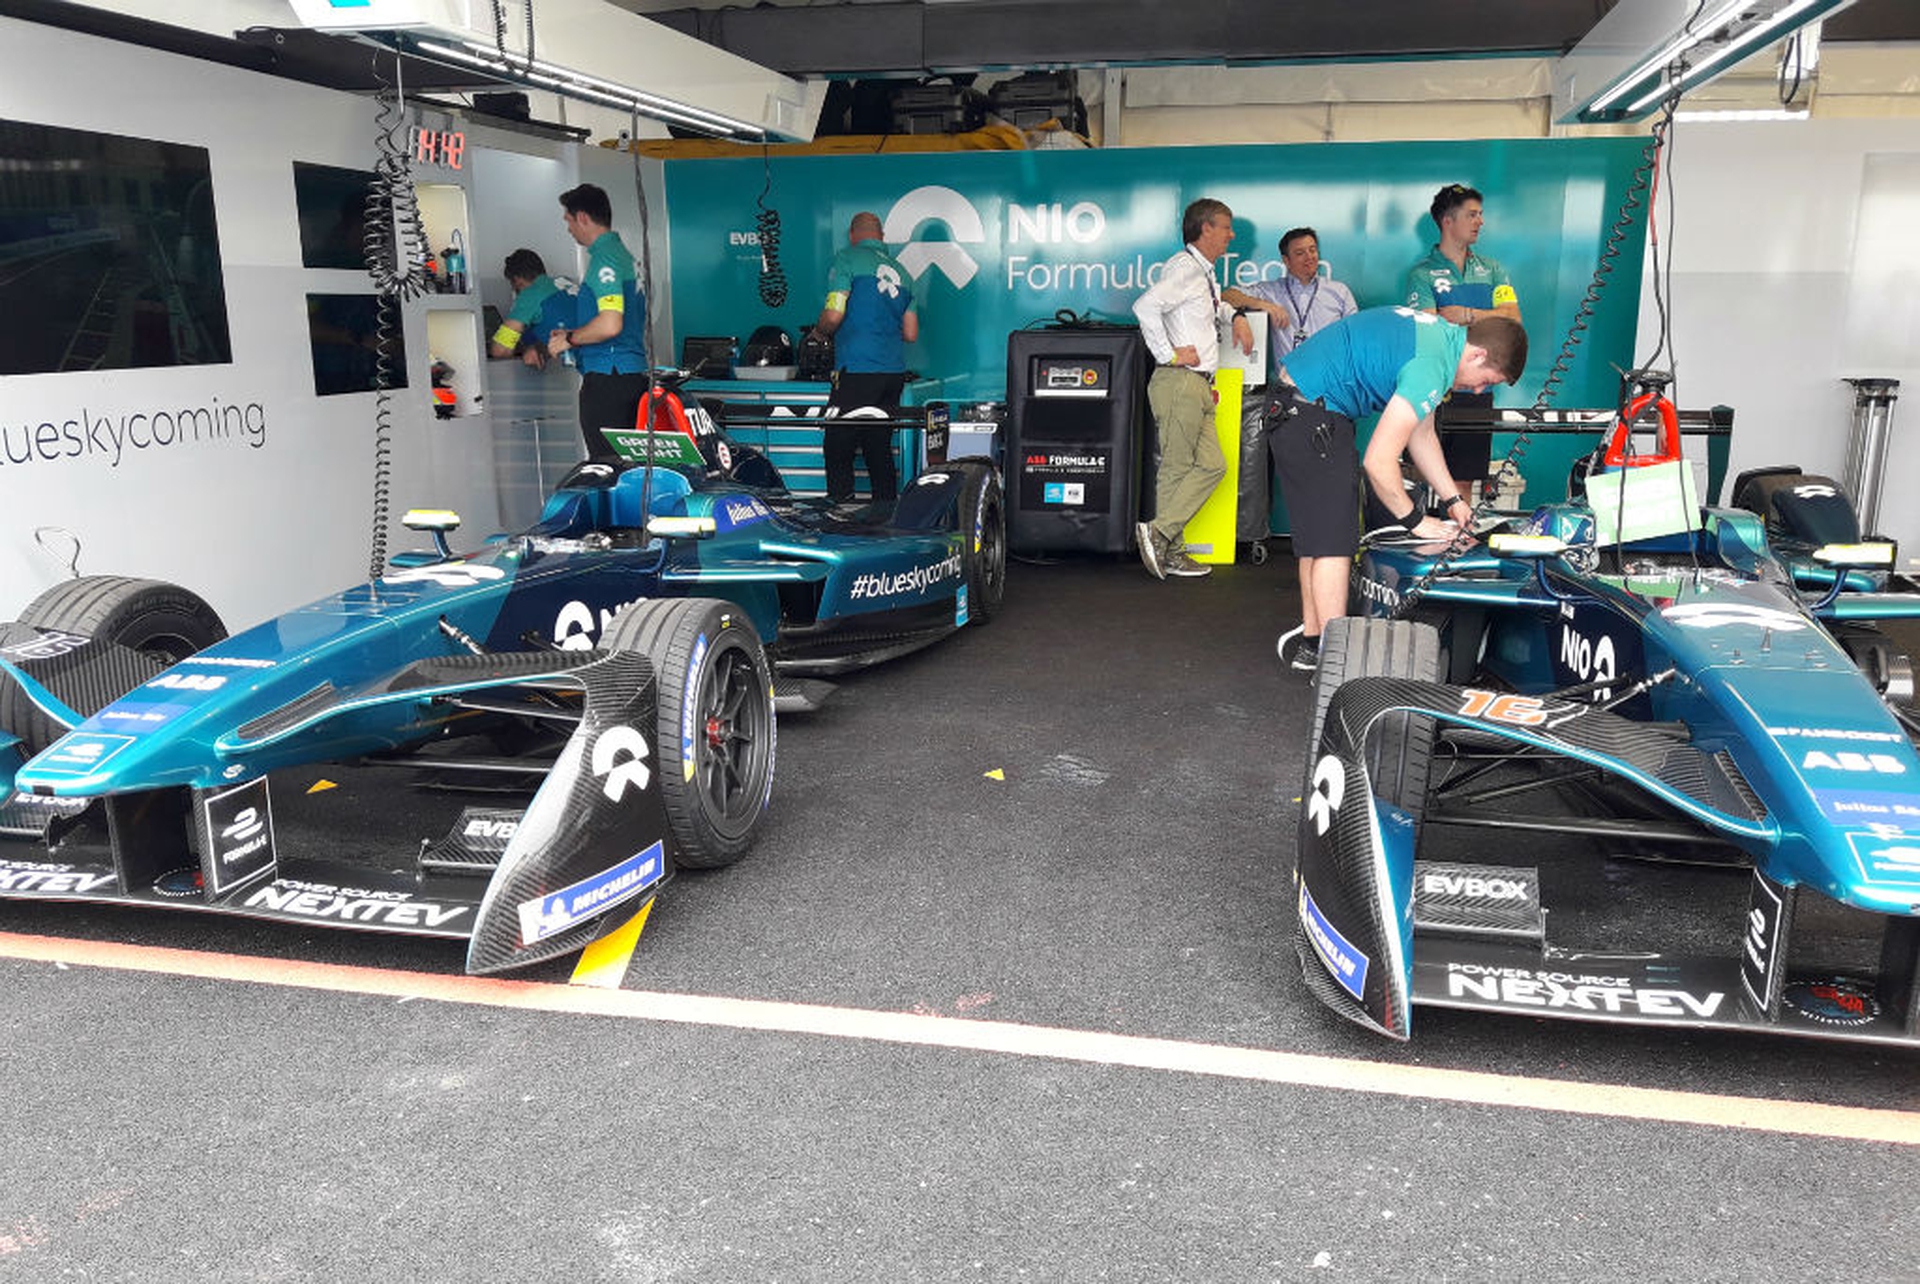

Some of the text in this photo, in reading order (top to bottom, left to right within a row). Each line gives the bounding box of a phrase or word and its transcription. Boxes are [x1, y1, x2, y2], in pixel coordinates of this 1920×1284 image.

[1008, 201, 1105, 244] NIO
[0, 396, 266, 467] ueskycoming
[851, 546, 961, 599] #blueskycoming
[1561, 624, 1591, 681] NIO
[1457, 688, 1548, 726] 16
[1802, 751, 1906, 774] ABB
[464, 820, 518, 838] EVB
[244, 886, 469, 927] NEXTEV
[571, 857, 656, 914] MICHELIN
[1423, 875, 1528, 900] EVBOX
[1448, 963, 1630, 987] POWER SOURCE
[1448, 973, 1725, 1017] NEXTEV
